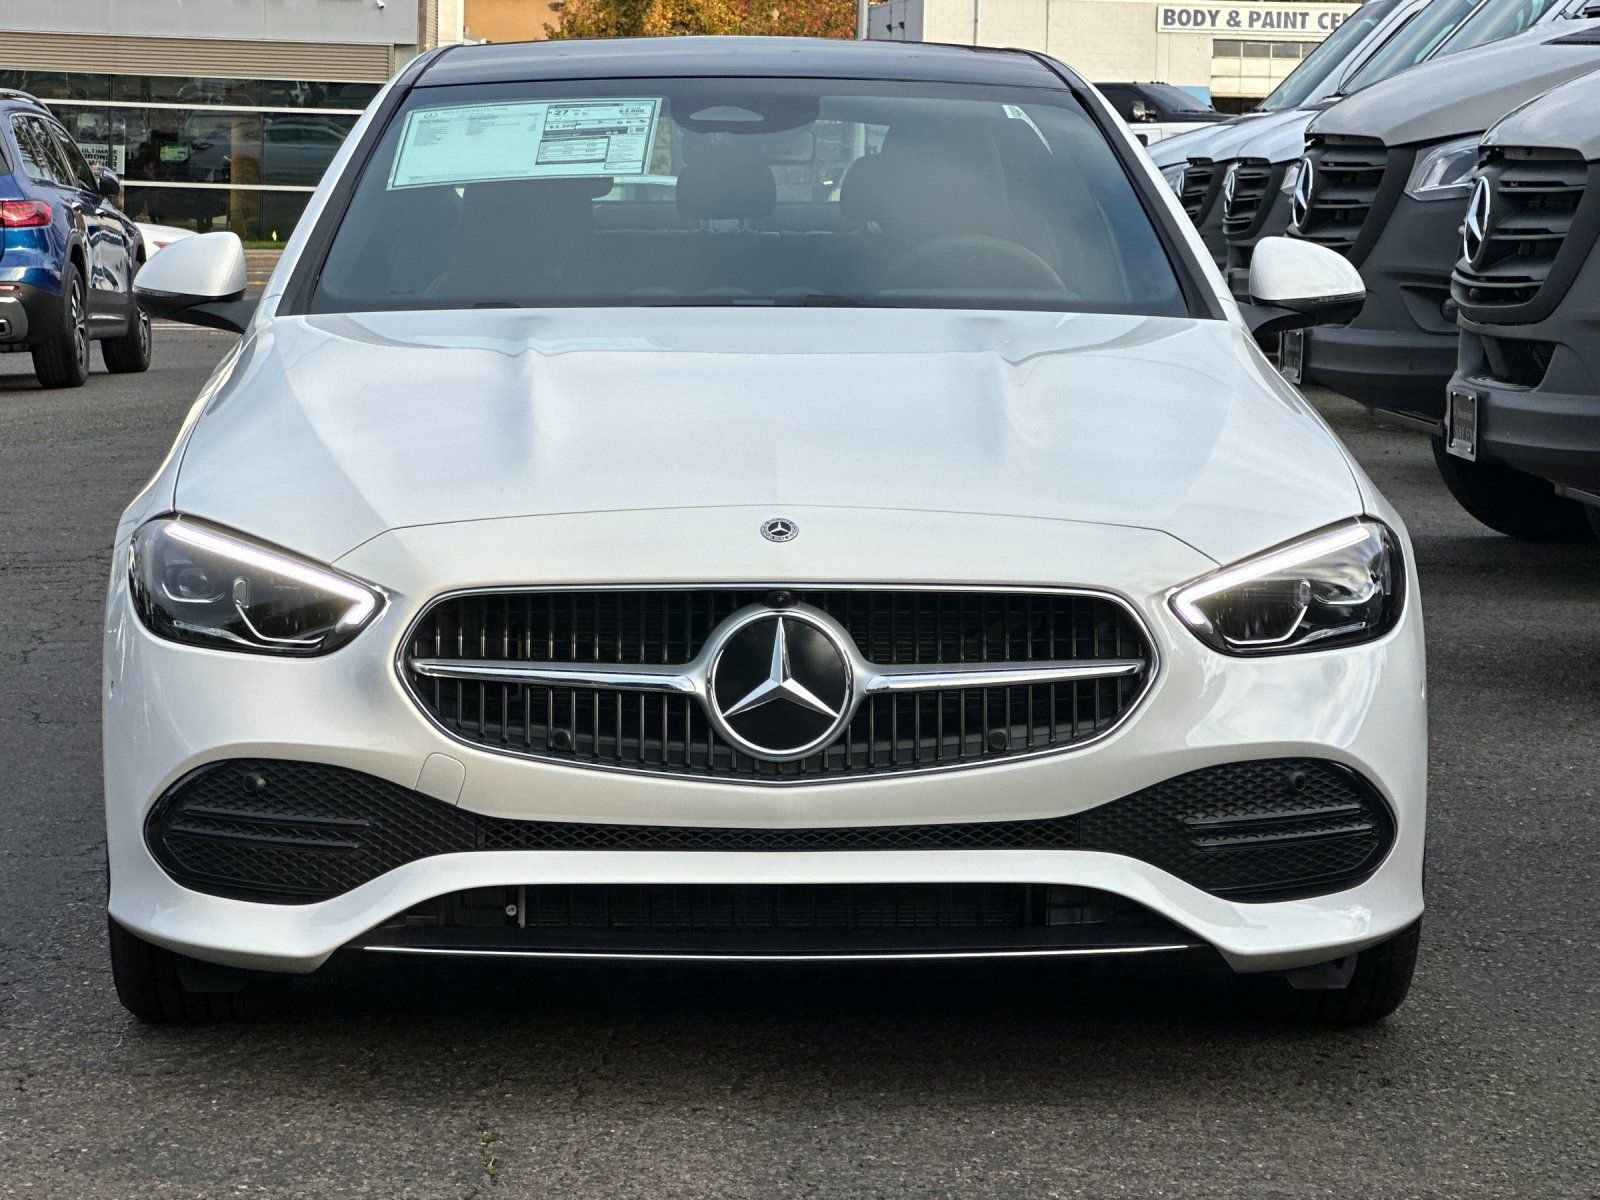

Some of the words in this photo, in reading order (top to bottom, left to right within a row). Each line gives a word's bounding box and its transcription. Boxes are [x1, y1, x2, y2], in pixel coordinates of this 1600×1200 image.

[1163, 8, 1221, 28] BODY
[1226, 10, 1242, 28] &
[1249, 11, 1310, 30] PAINT
